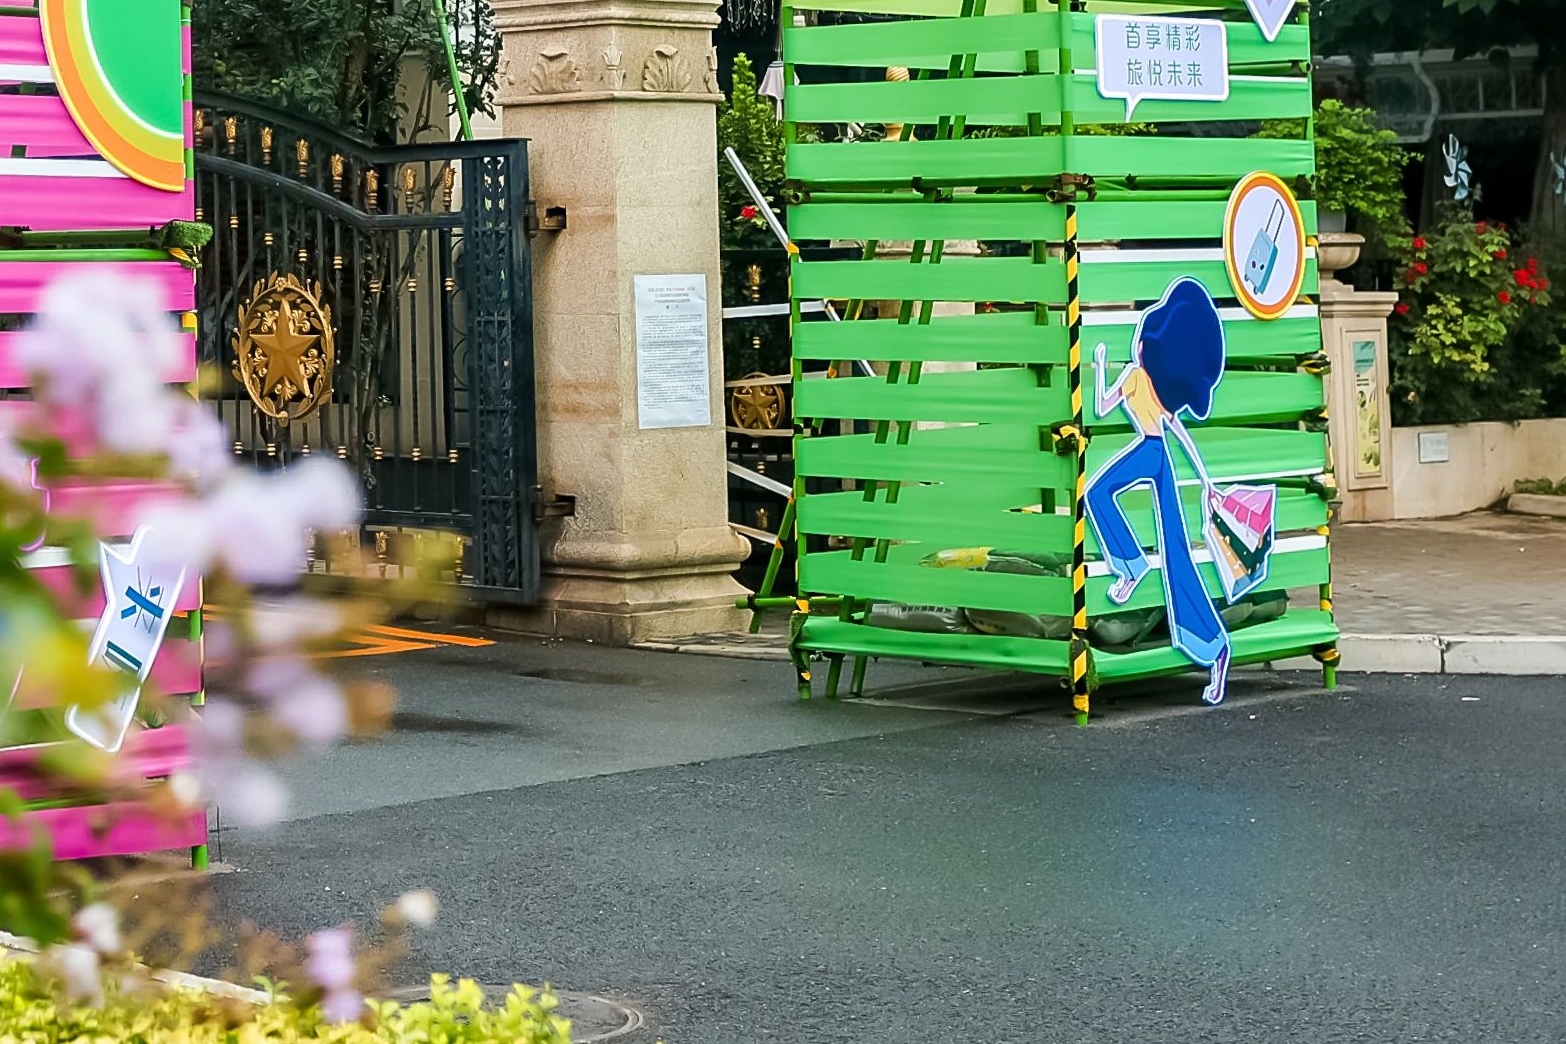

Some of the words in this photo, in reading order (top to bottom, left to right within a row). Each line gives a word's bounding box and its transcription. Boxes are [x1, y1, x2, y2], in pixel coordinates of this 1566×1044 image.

[1125, 22, 1201, 52] 首享精彩
[1126, 58, 1203, 88] 旅悦未来
